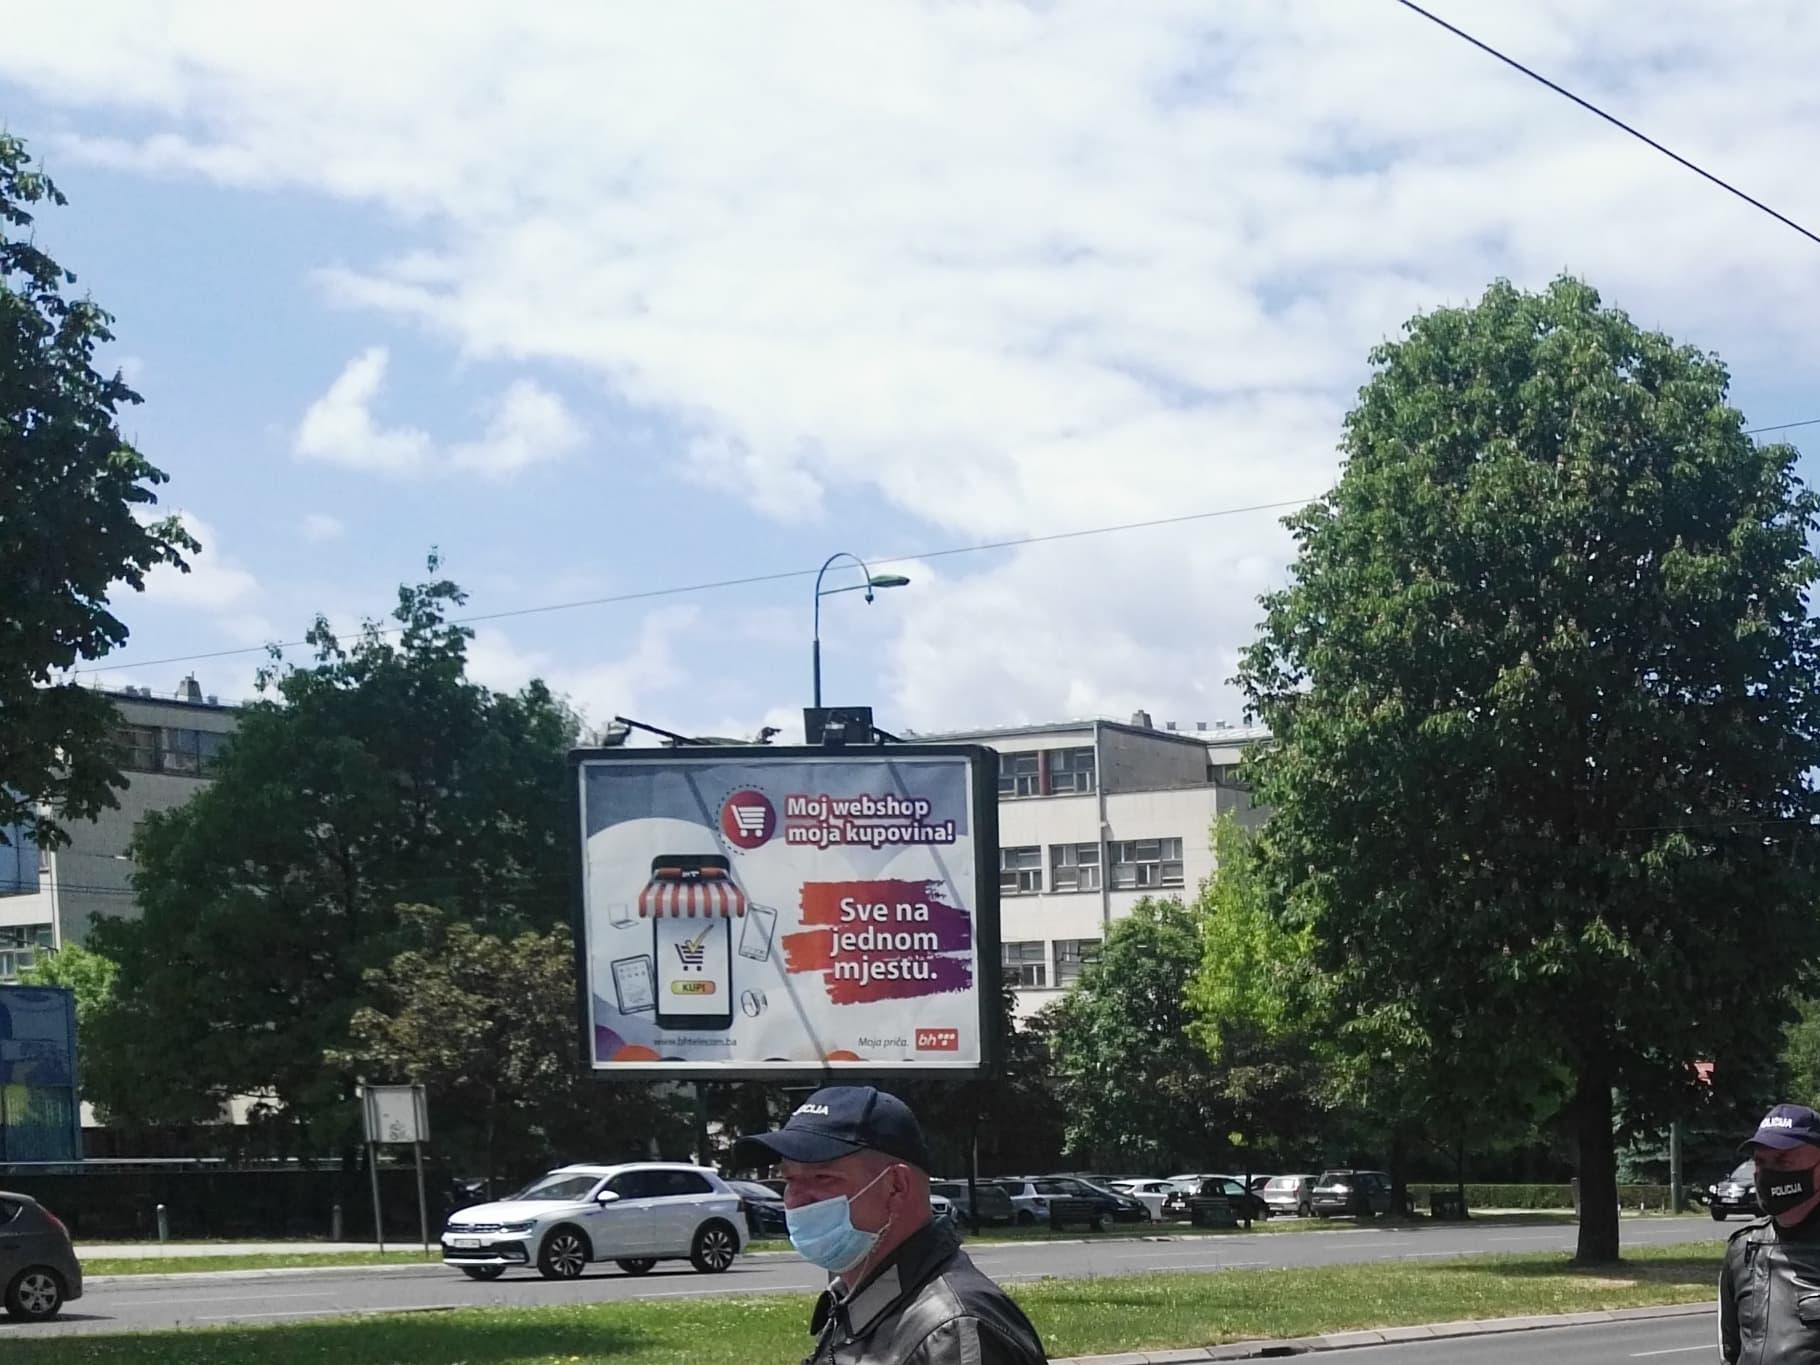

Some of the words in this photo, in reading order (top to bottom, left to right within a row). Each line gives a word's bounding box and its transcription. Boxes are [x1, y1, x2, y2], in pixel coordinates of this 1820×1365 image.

[788, 798, 829, 820] Moj
[832, 796, 929, 820] webshop
[788, 826, 840, 848] moja
[846, 823, 954, 847] kupovina!
[840, 898, 888, 922] Sve
[895, 903, 929, 922] na
[831, 927, 938, 956] jednom
[834, 958, 938, 985] mjestu.
[682, 984, 706, 992] KUPI
[858, 1037, 881, 1048] Moja
[1771, 1183, 1803, 1197] POLICIJA
